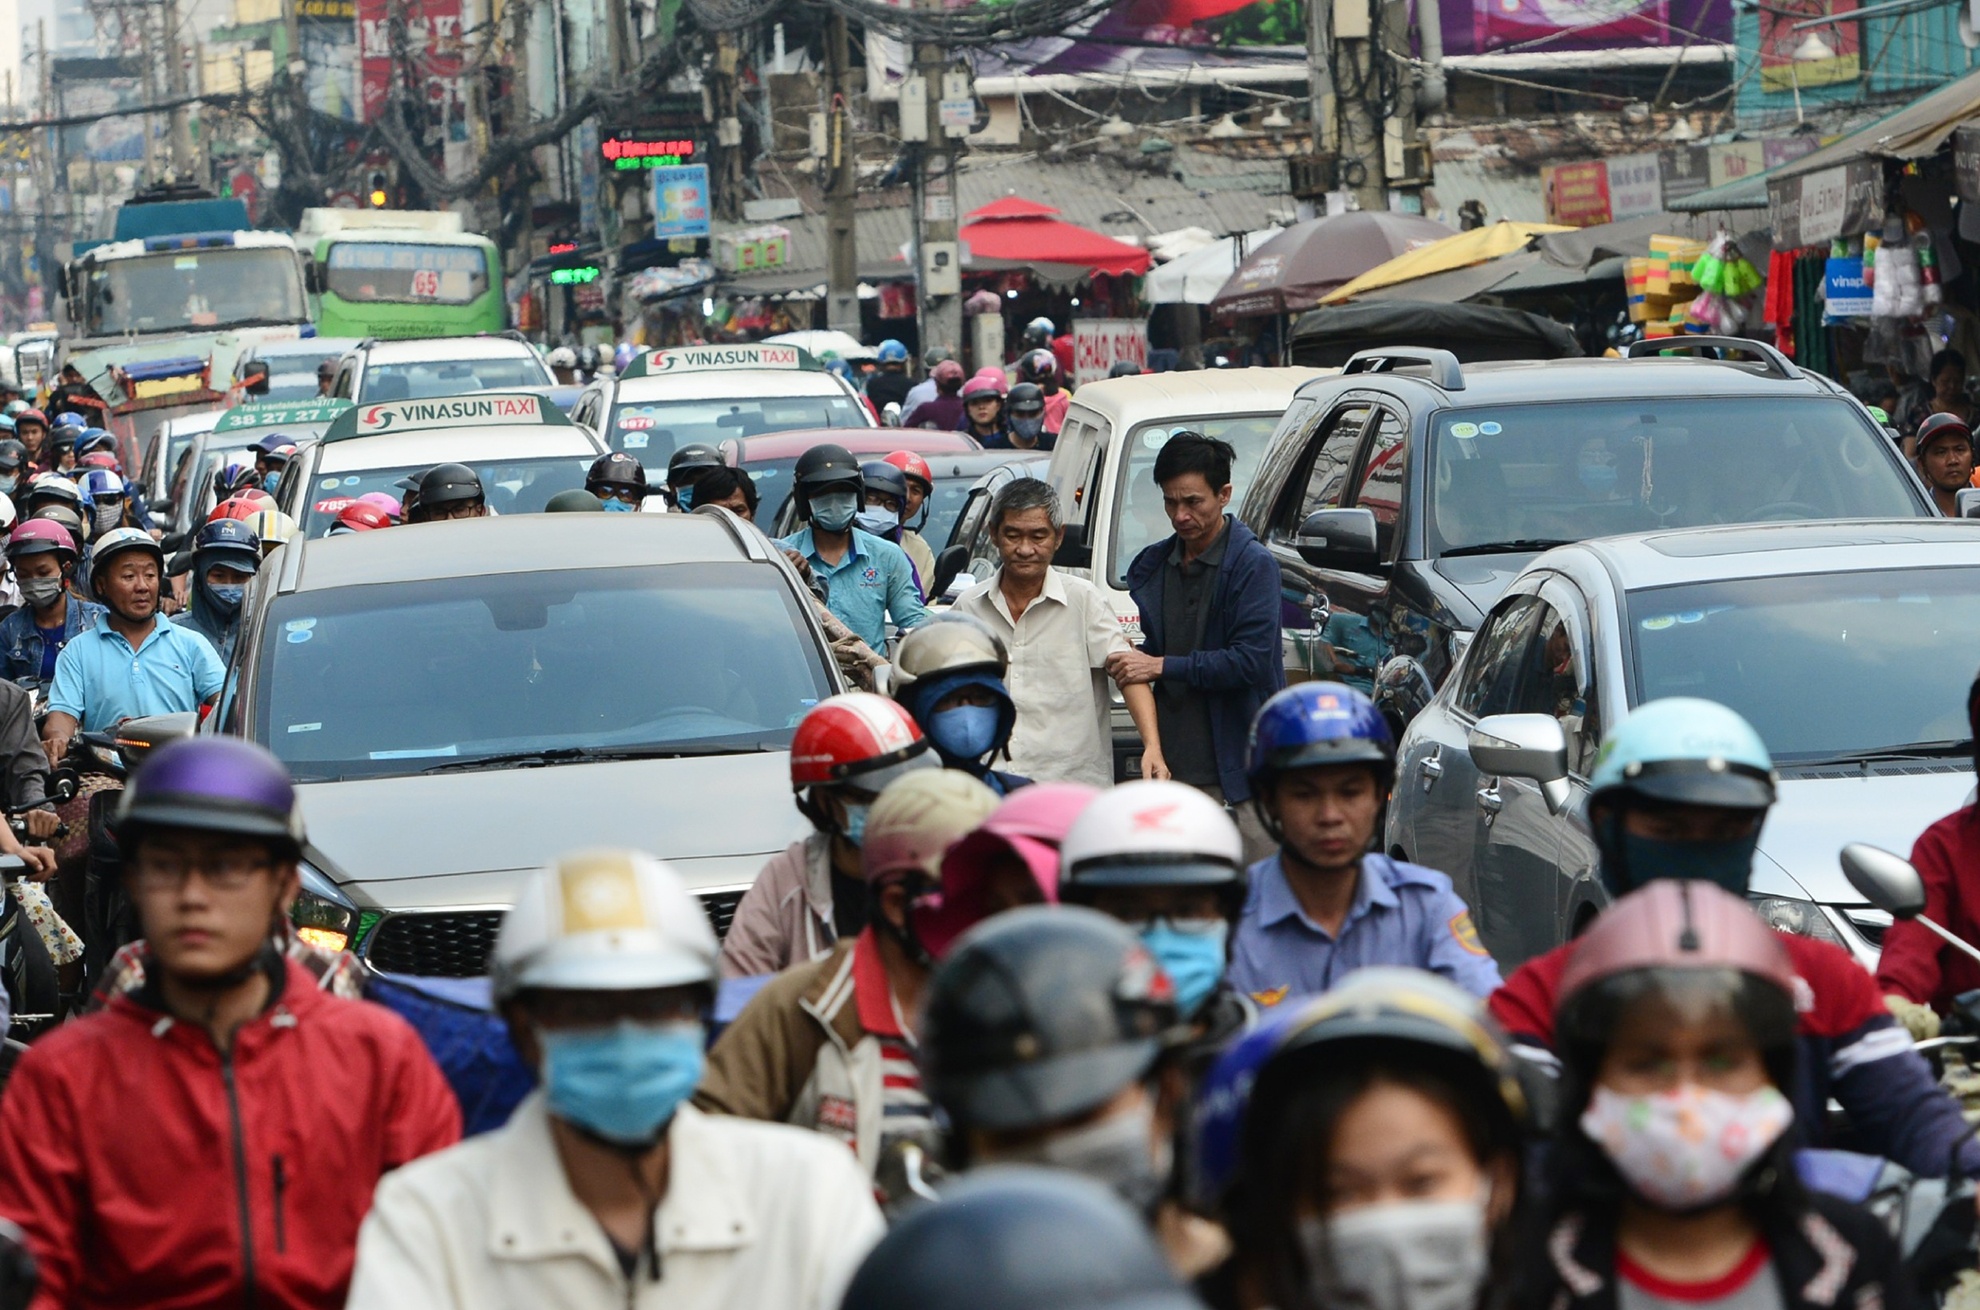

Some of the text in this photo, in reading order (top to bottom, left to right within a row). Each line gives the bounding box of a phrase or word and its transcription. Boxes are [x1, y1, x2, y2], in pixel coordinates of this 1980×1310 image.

[1832, 275, 1864, 289] vinap
[761, 350, 795, 362] TAXI
[494, 399, 535, 416] TAXI
[261, 411, 287, 424] 27
[295, 409, 320, 422] 27
